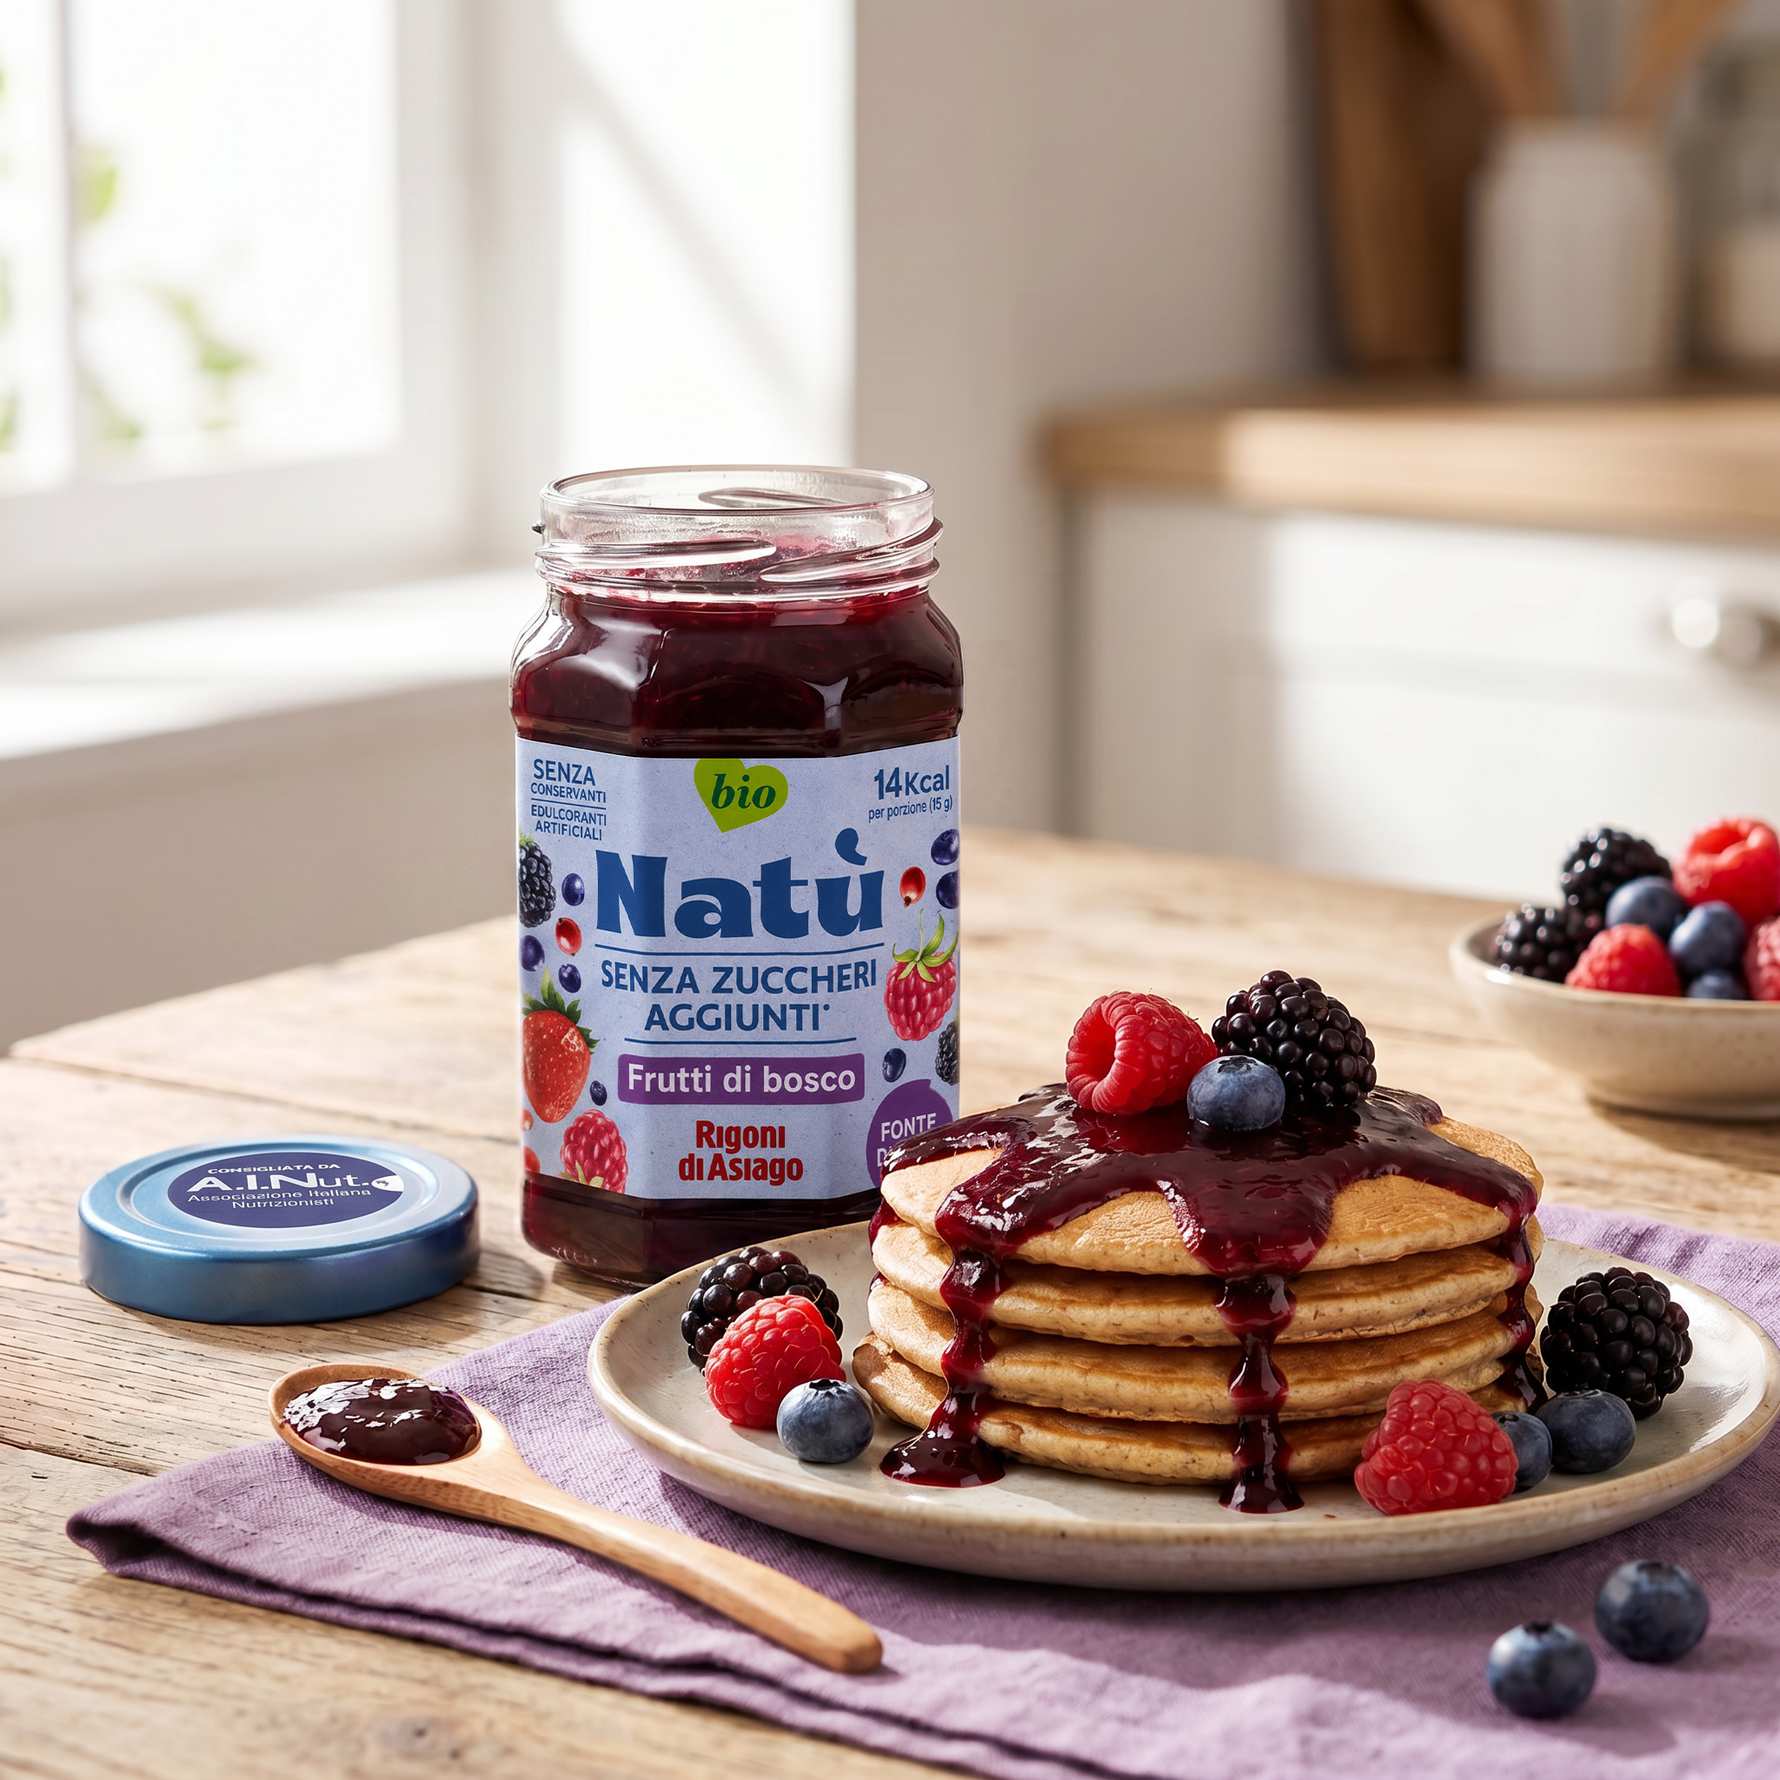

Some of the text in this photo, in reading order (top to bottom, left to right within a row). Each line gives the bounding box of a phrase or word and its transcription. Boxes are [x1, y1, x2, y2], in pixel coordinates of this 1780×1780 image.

[533, 758, 596, 786] SENZA
[530, 782, 606, 803] CONSERVANTI
[711, 773, 776, 809] bio
[531, 804, 607, 826] EDULCORANTI
[868, 806, 885, 823] per
[887, 801, 927, 821] porzione
[535, 819, 602, 841] ARTIFICIALI
[595, 827, 885, 939] Natù
[601, 958, 877, 994] SENZA ZUCCHERI
[628, 1062, 856, 1092] Frutti di bosco
[696, 1120, 786, 1154] Rigoni
[207, 1164, 314, 1174] CONSIGLIATA
[707, 1153, 804, 1186] Asiago
[187, 1189, 371, 1202] Associazione Italiana
